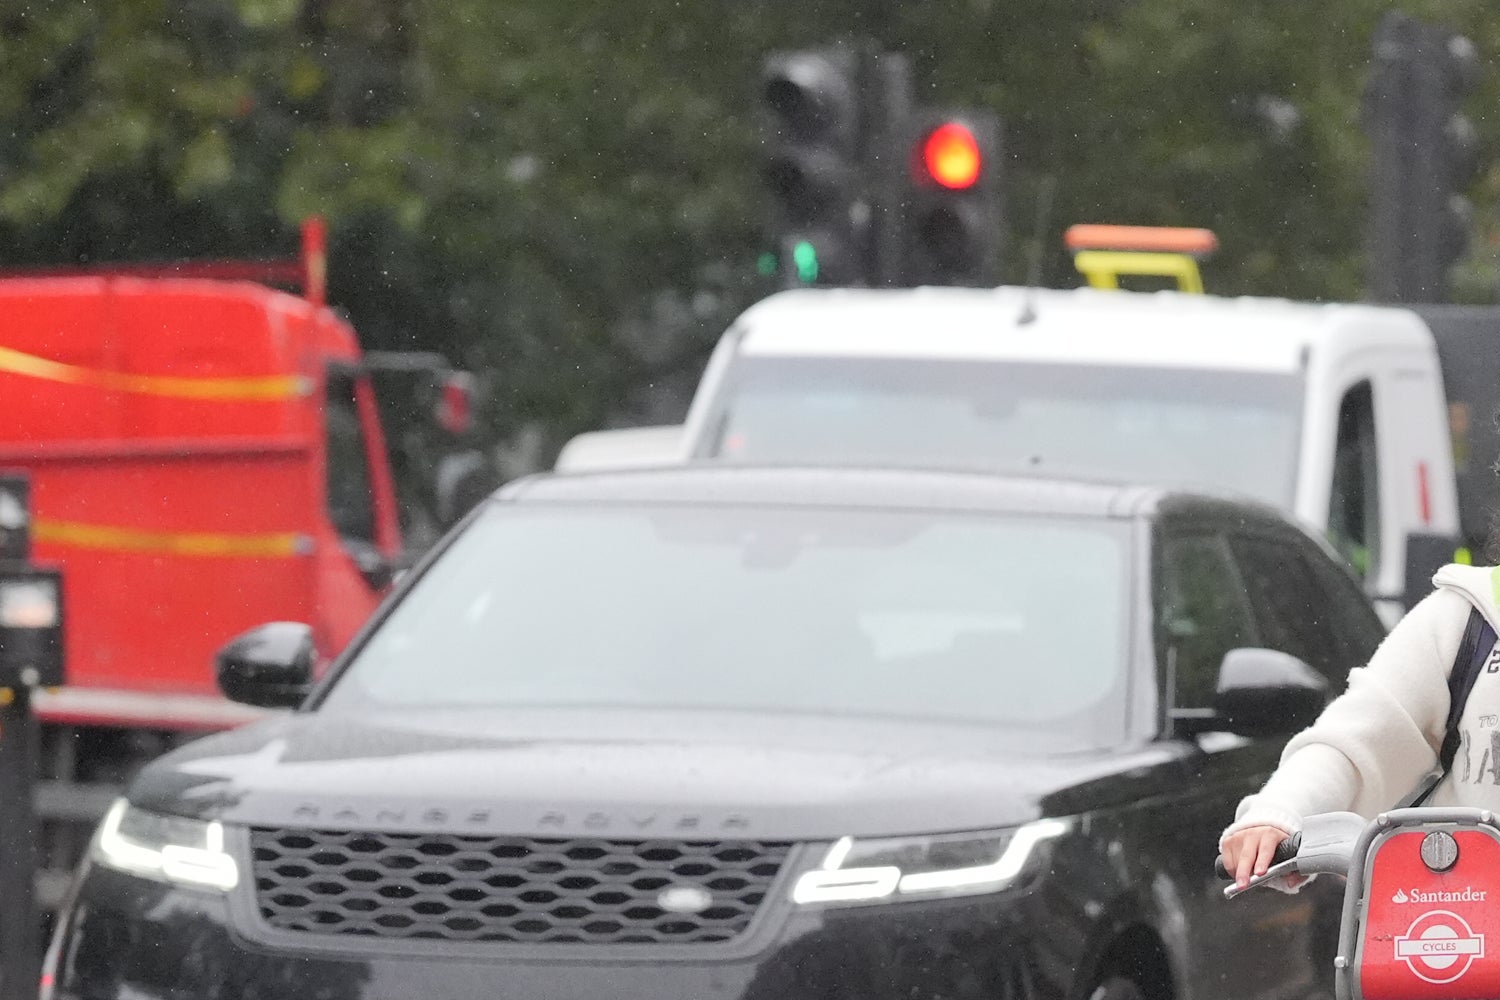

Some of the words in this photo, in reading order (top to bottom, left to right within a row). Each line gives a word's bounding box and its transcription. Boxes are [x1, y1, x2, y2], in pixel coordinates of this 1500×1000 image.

[1479, 714, 1498, 729] TO
[293, 805, 491, 825] RANGE
[537, 810, 749, 830] ROVER
[1410, 886, 1487, 903] Santander
[1422, 942, 1457, 952] CYCLES
